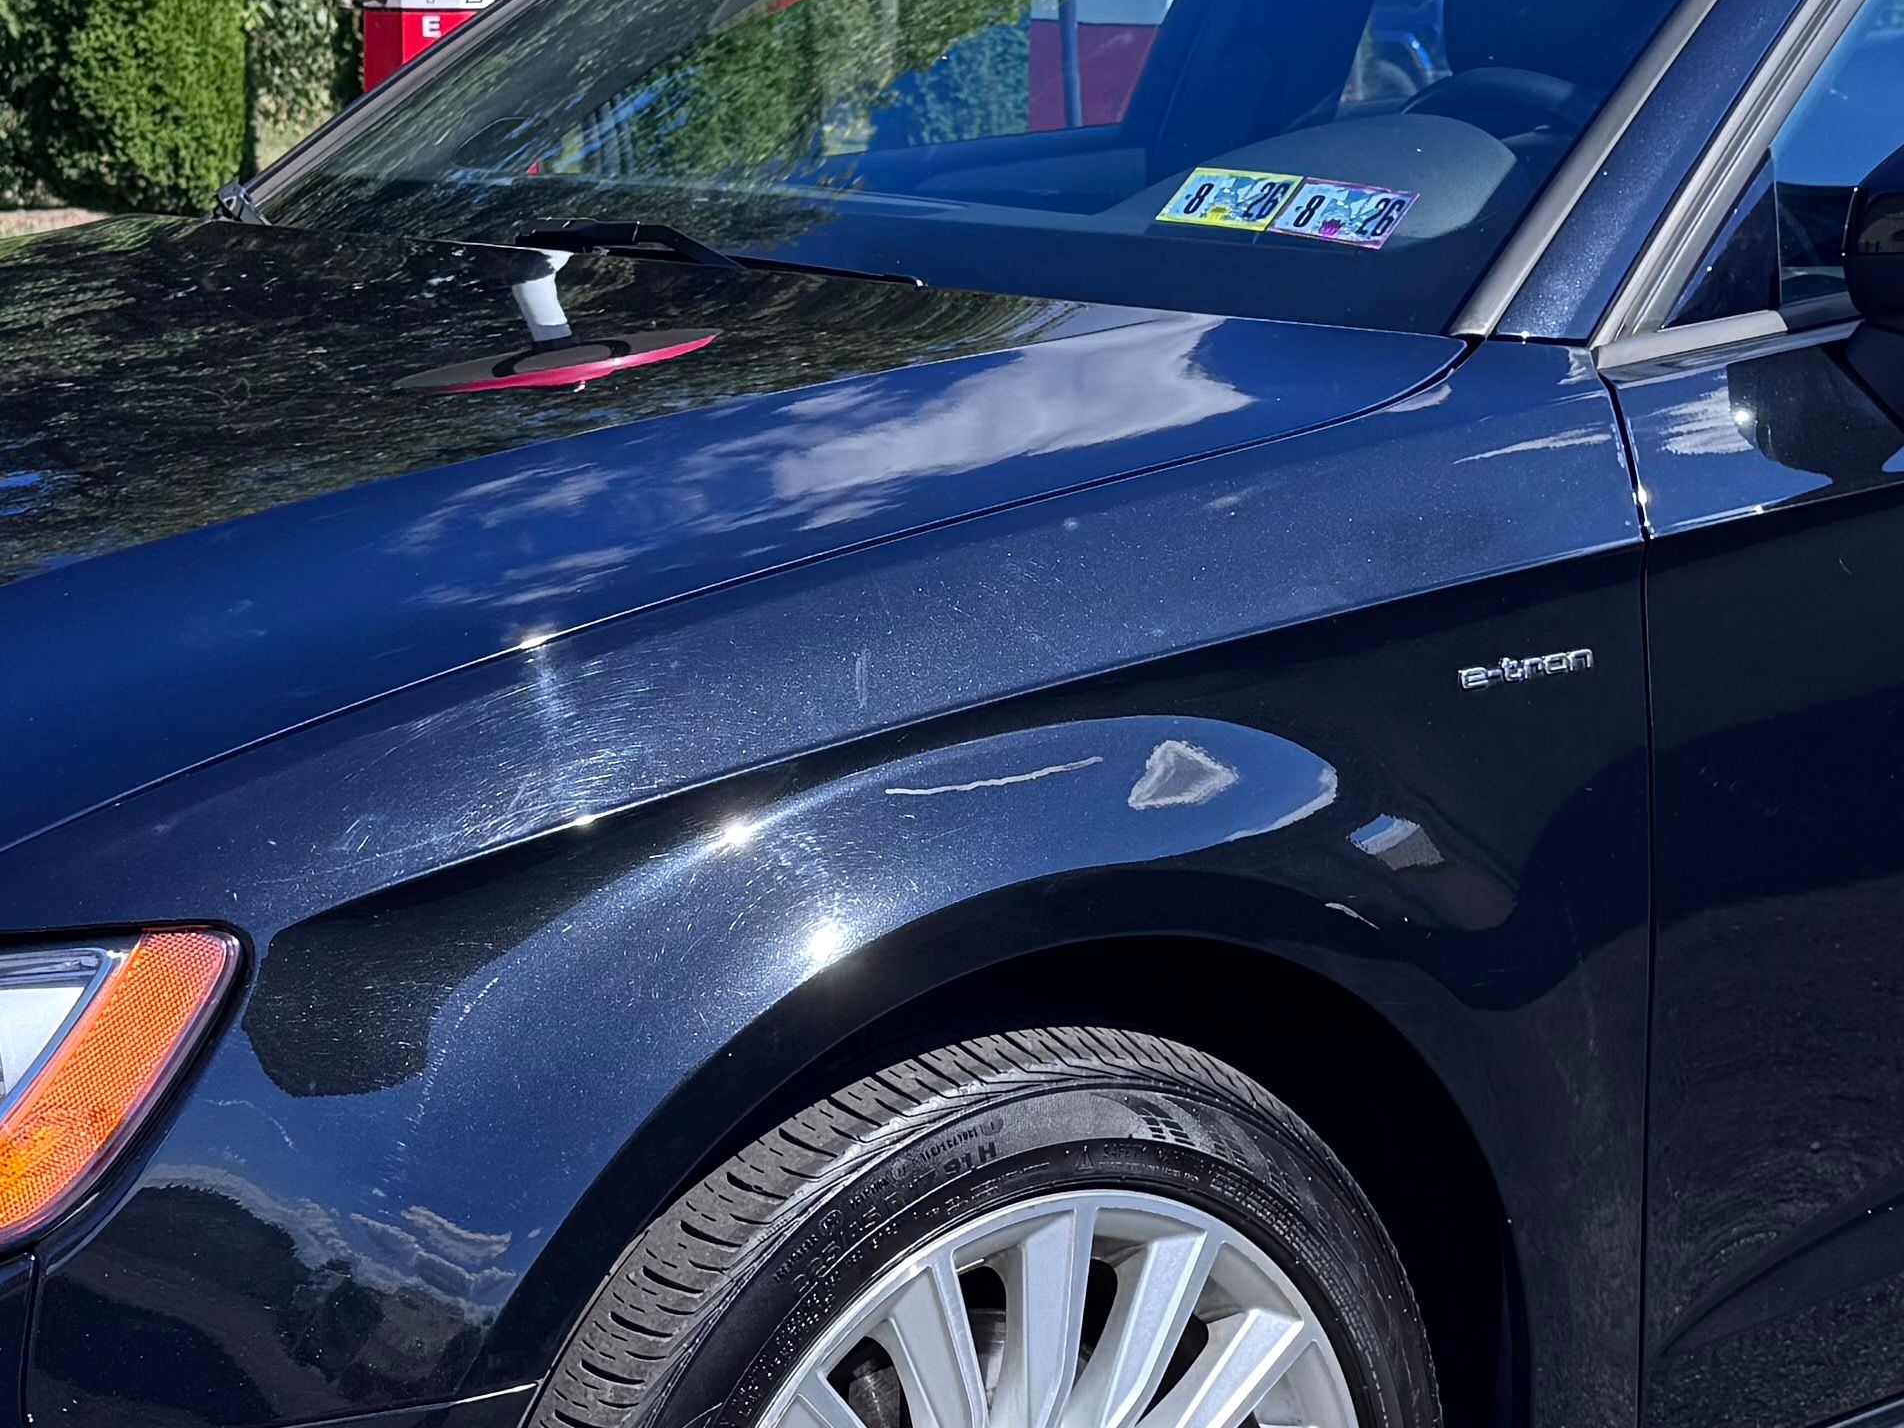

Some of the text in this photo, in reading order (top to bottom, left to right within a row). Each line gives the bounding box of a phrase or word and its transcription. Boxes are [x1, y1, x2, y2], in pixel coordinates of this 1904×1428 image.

[1182, 181, 1292, 221] 8 26
[1292, 194, 1407, 238] 8 26
[1457, 647, 1595, 691] e-tron
